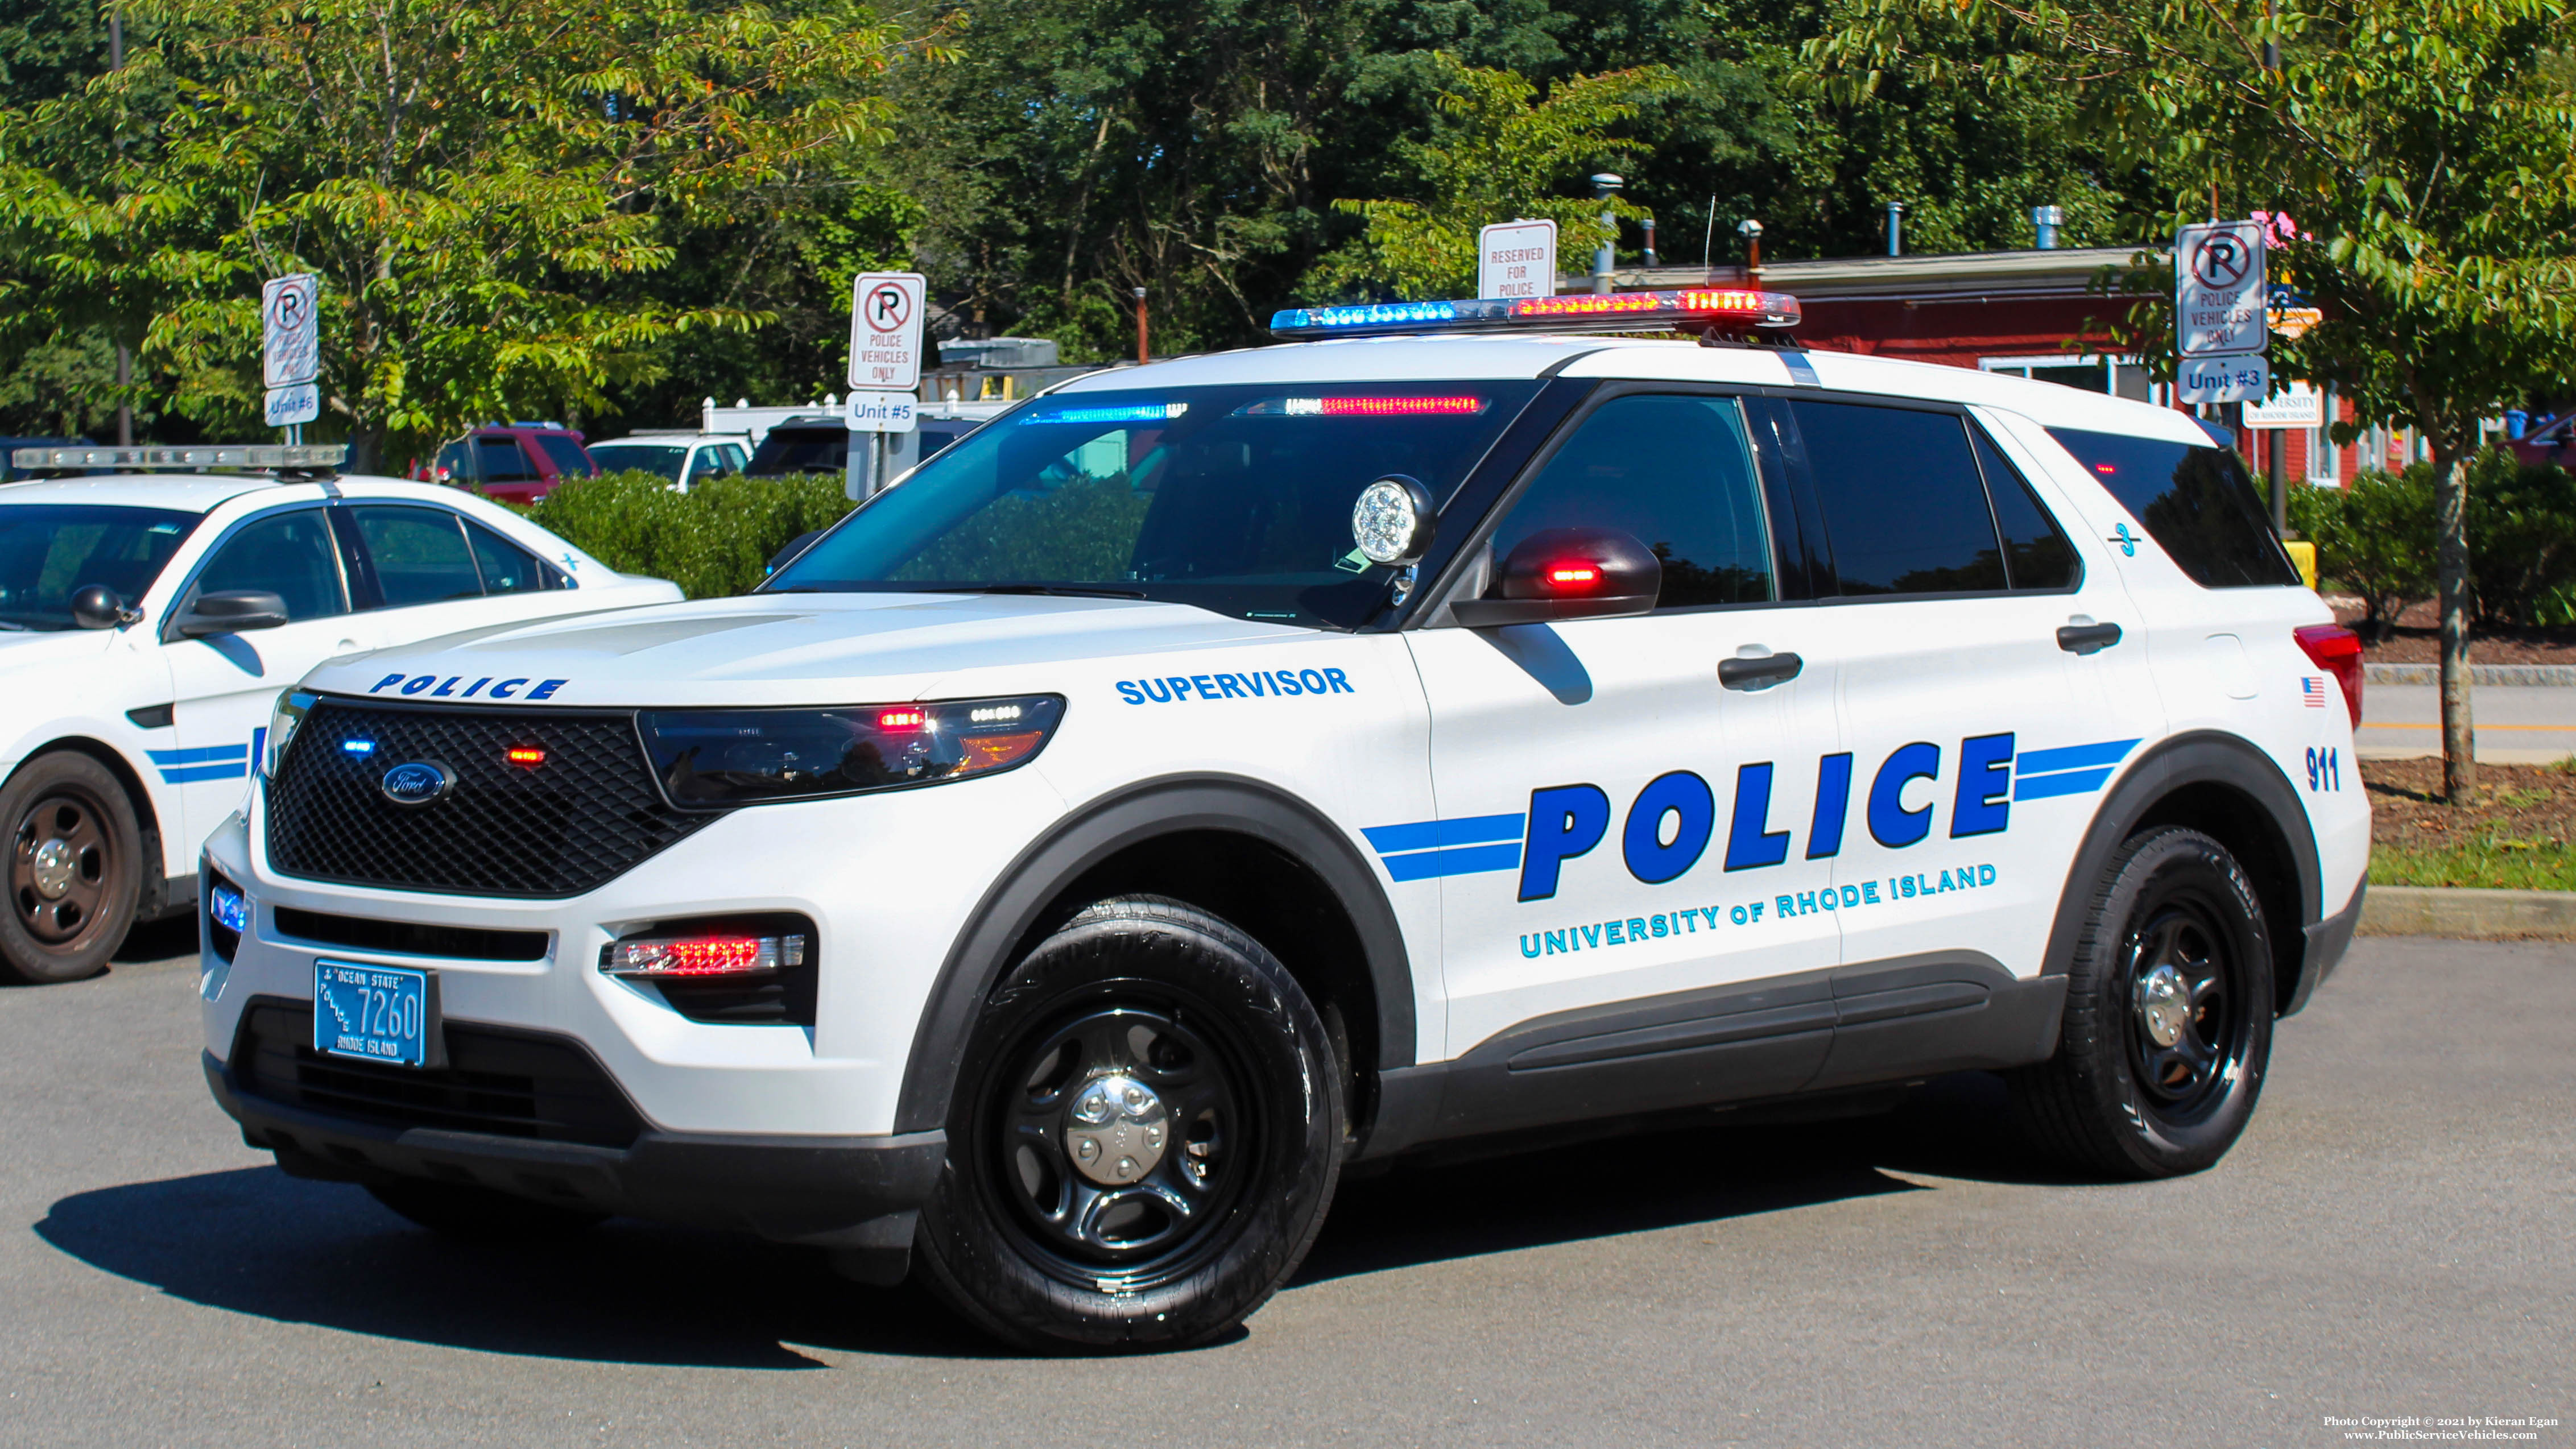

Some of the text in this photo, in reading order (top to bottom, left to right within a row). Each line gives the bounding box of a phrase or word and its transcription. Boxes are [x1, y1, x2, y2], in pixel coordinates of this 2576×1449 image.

[1491, 247, 1544, 264] RESERVED
[1507, 266, 1527, 279] FOR
[1499, 282, 1534, 297] POLICE
[2200, 291, 2241, 307] POLICE
[2192, 309, 2252, 326] VEHICLES
[869, 334, 902, 347] POLICE
[2206, 328, 2236, 344] ONLY
[861, 350, 909, 363] VEHICLES
[872, 367, 896, 380] ONLY
[2188, 370, 2261, 389] Unit #3
[271, 396, 313, 415] Unit #6
[854, 403, 911, 420] Unit #5
[367, 673, 570, 700] POLICE
[1115, 668, 1355, 705] SUPERVISOR
[2306, 746, 2341, 792] 911
[392, 771, 425, 793] Ford
[1517, 731, 2015, 902] POLICE
[1520, 864, 1998, 959] UNIVERSITY OF RHODE ISLAND
[320, 984, 350, 1033] POLICE
[357, 987, 417, 1040] 7260
[337, 1035, 398, 1057] RHODE ISLAND
